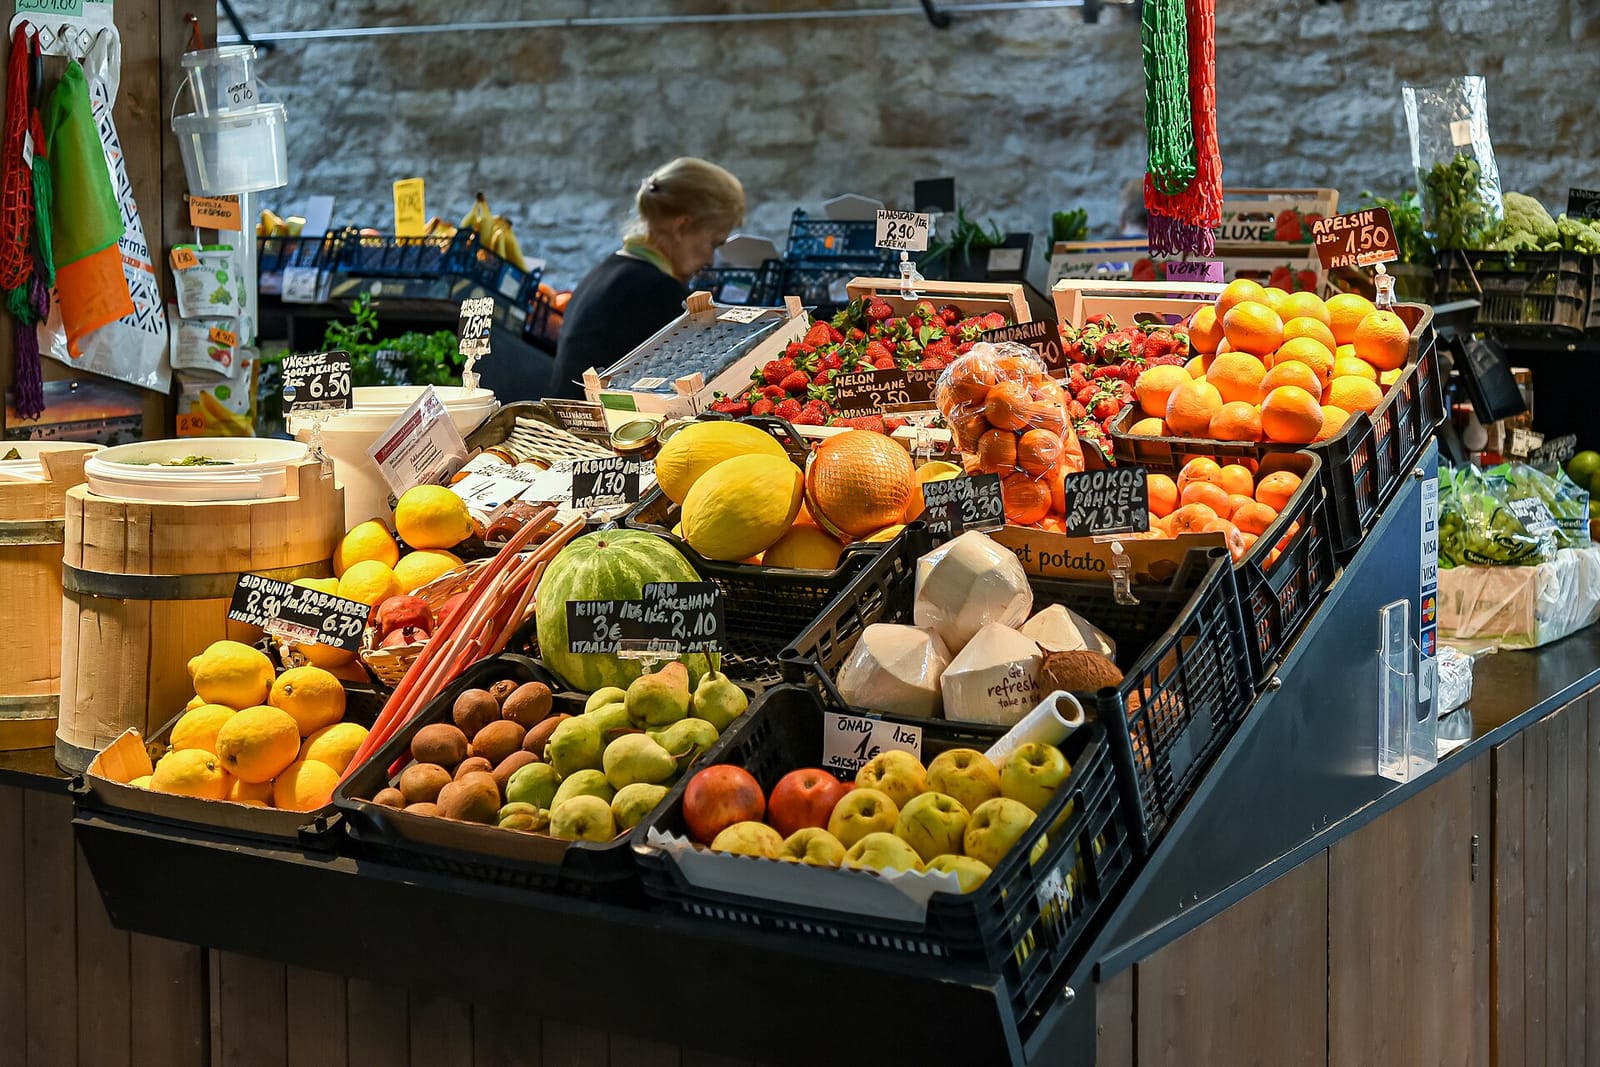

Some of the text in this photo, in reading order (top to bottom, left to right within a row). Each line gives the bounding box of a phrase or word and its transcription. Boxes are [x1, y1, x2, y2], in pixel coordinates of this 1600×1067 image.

[886, 221, 915, 241] 2.90
[1213, 225, 1270, 241] ELUXE
[1312, 211, 1374, 234] APELSIN
[118, 236, 149, 258] erma
[878, 240, 907, 249] KREEKA
[1345, 224, 1389, 254] 1.50
[981, 321, 1047, 344] MANDARIIN
[309, 371, 350, 398] 6.50
[573, 457, 624, 475] ARBUUS
[591, 471, 626, 495] 1.70
[924, 476, 972, 498] KOOKOS
[1065, 468, 1144, 493] KOOKOS
[961, 495, 1003, 522] 3.30
[1085, 505, 1129, 533] 1.35
[1423, 540, 1437, 555] VISA
[1039, 549, 1105, 572] potato
[1422, 565, 1437, 581] VISA
[238, 574, 295, 597] SIDRUNID
[644, 583, 678, 599] PIRN
[246, 590, 281, 618] 2.90
[299, 589, 370, 619] RABARBER
[575, 601, 614, 617] KIIWI
[322, 613, 363, 637] 6.70
[592, 615, 623, 642] 3€
[671, 610, 717, 639] 2.10
[572, 641, 622, 654] ITAALIA
[987, 674, 1040, 697] refresh
[998, 698, 1020, 709] take
